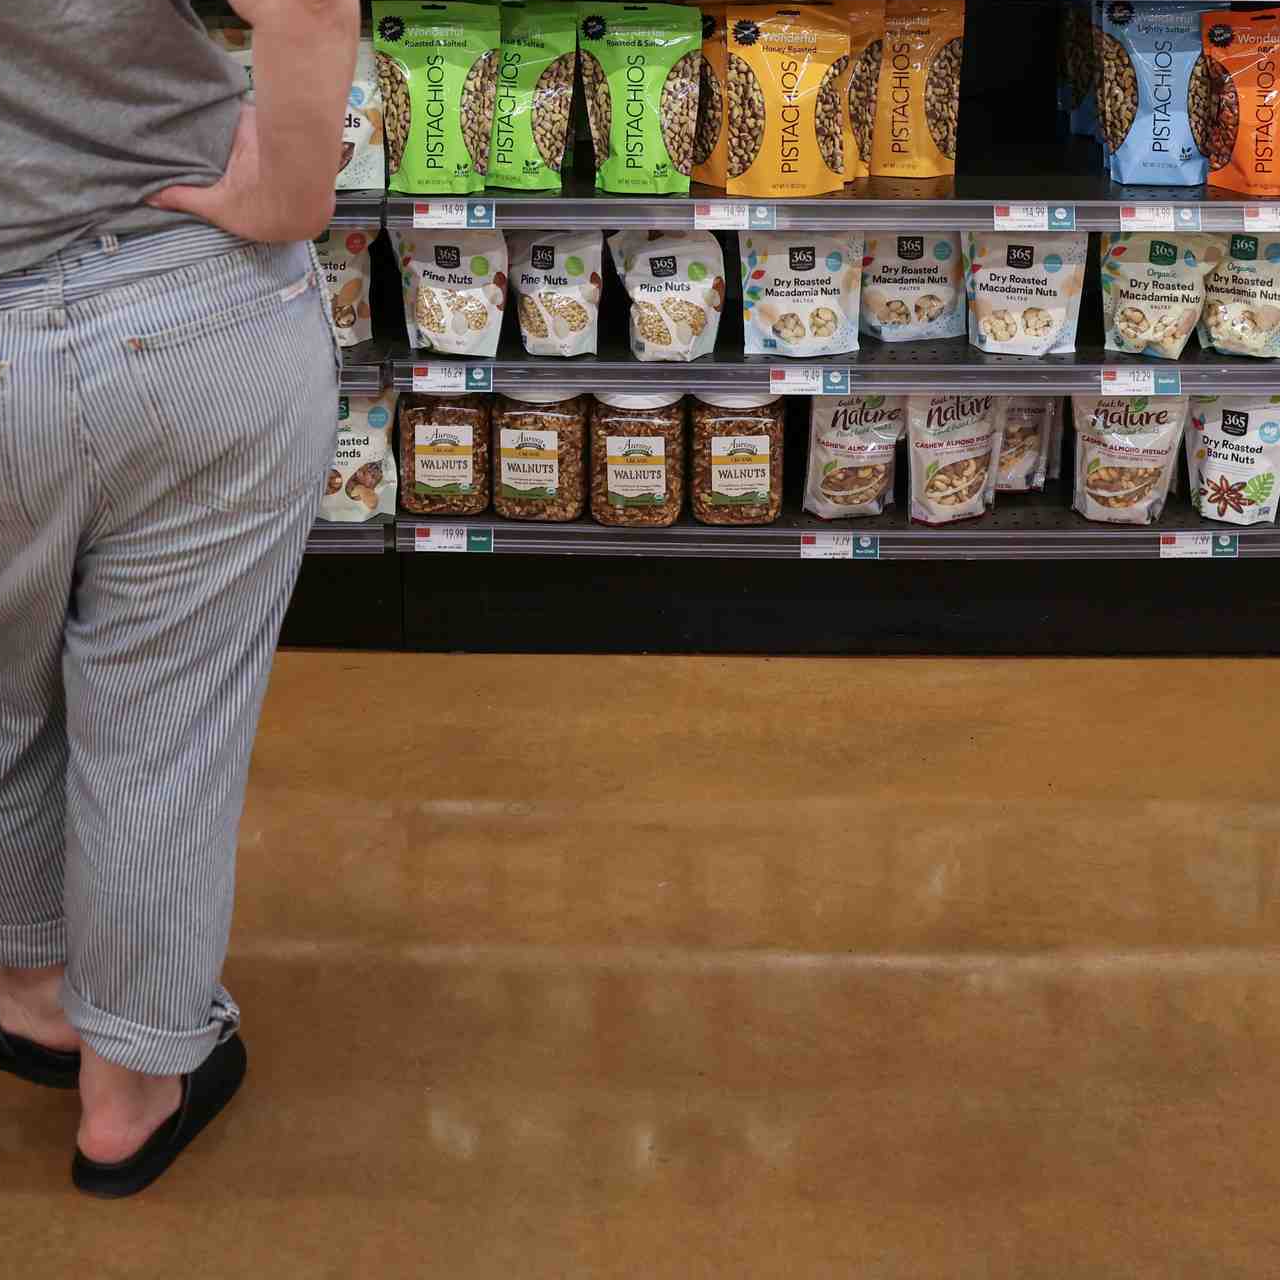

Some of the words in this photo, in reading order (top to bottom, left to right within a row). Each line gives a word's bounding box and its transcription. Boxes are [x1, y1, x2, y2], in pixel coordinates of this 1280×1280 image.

[405, 40, 436, 48] Roasted
[444, 40, 466, 48] Salted
[892, 42, 909, 152] PISTACHIOS
[1153, 40, 1172, 152] PISTACHIOS
[426, 55, 444, 168] PISTACHIOS
[781, 60, 798, 174] PISTACHIOS
[1255, 60, 1274, 173] PISTACHIOS
[422, 269, 444, 283] Pine
[448, 273, 472, 285] Nuts
[774, 278, 790, 291] Dry
[794, 276, 830, 286] Roasted
[765, 286, 816, 297] Macadamia
[820, 285, 840, 296] Nuts
[1092, 404, 1168, 428] nature
[420, 459, 468, 470] WALNUTS
